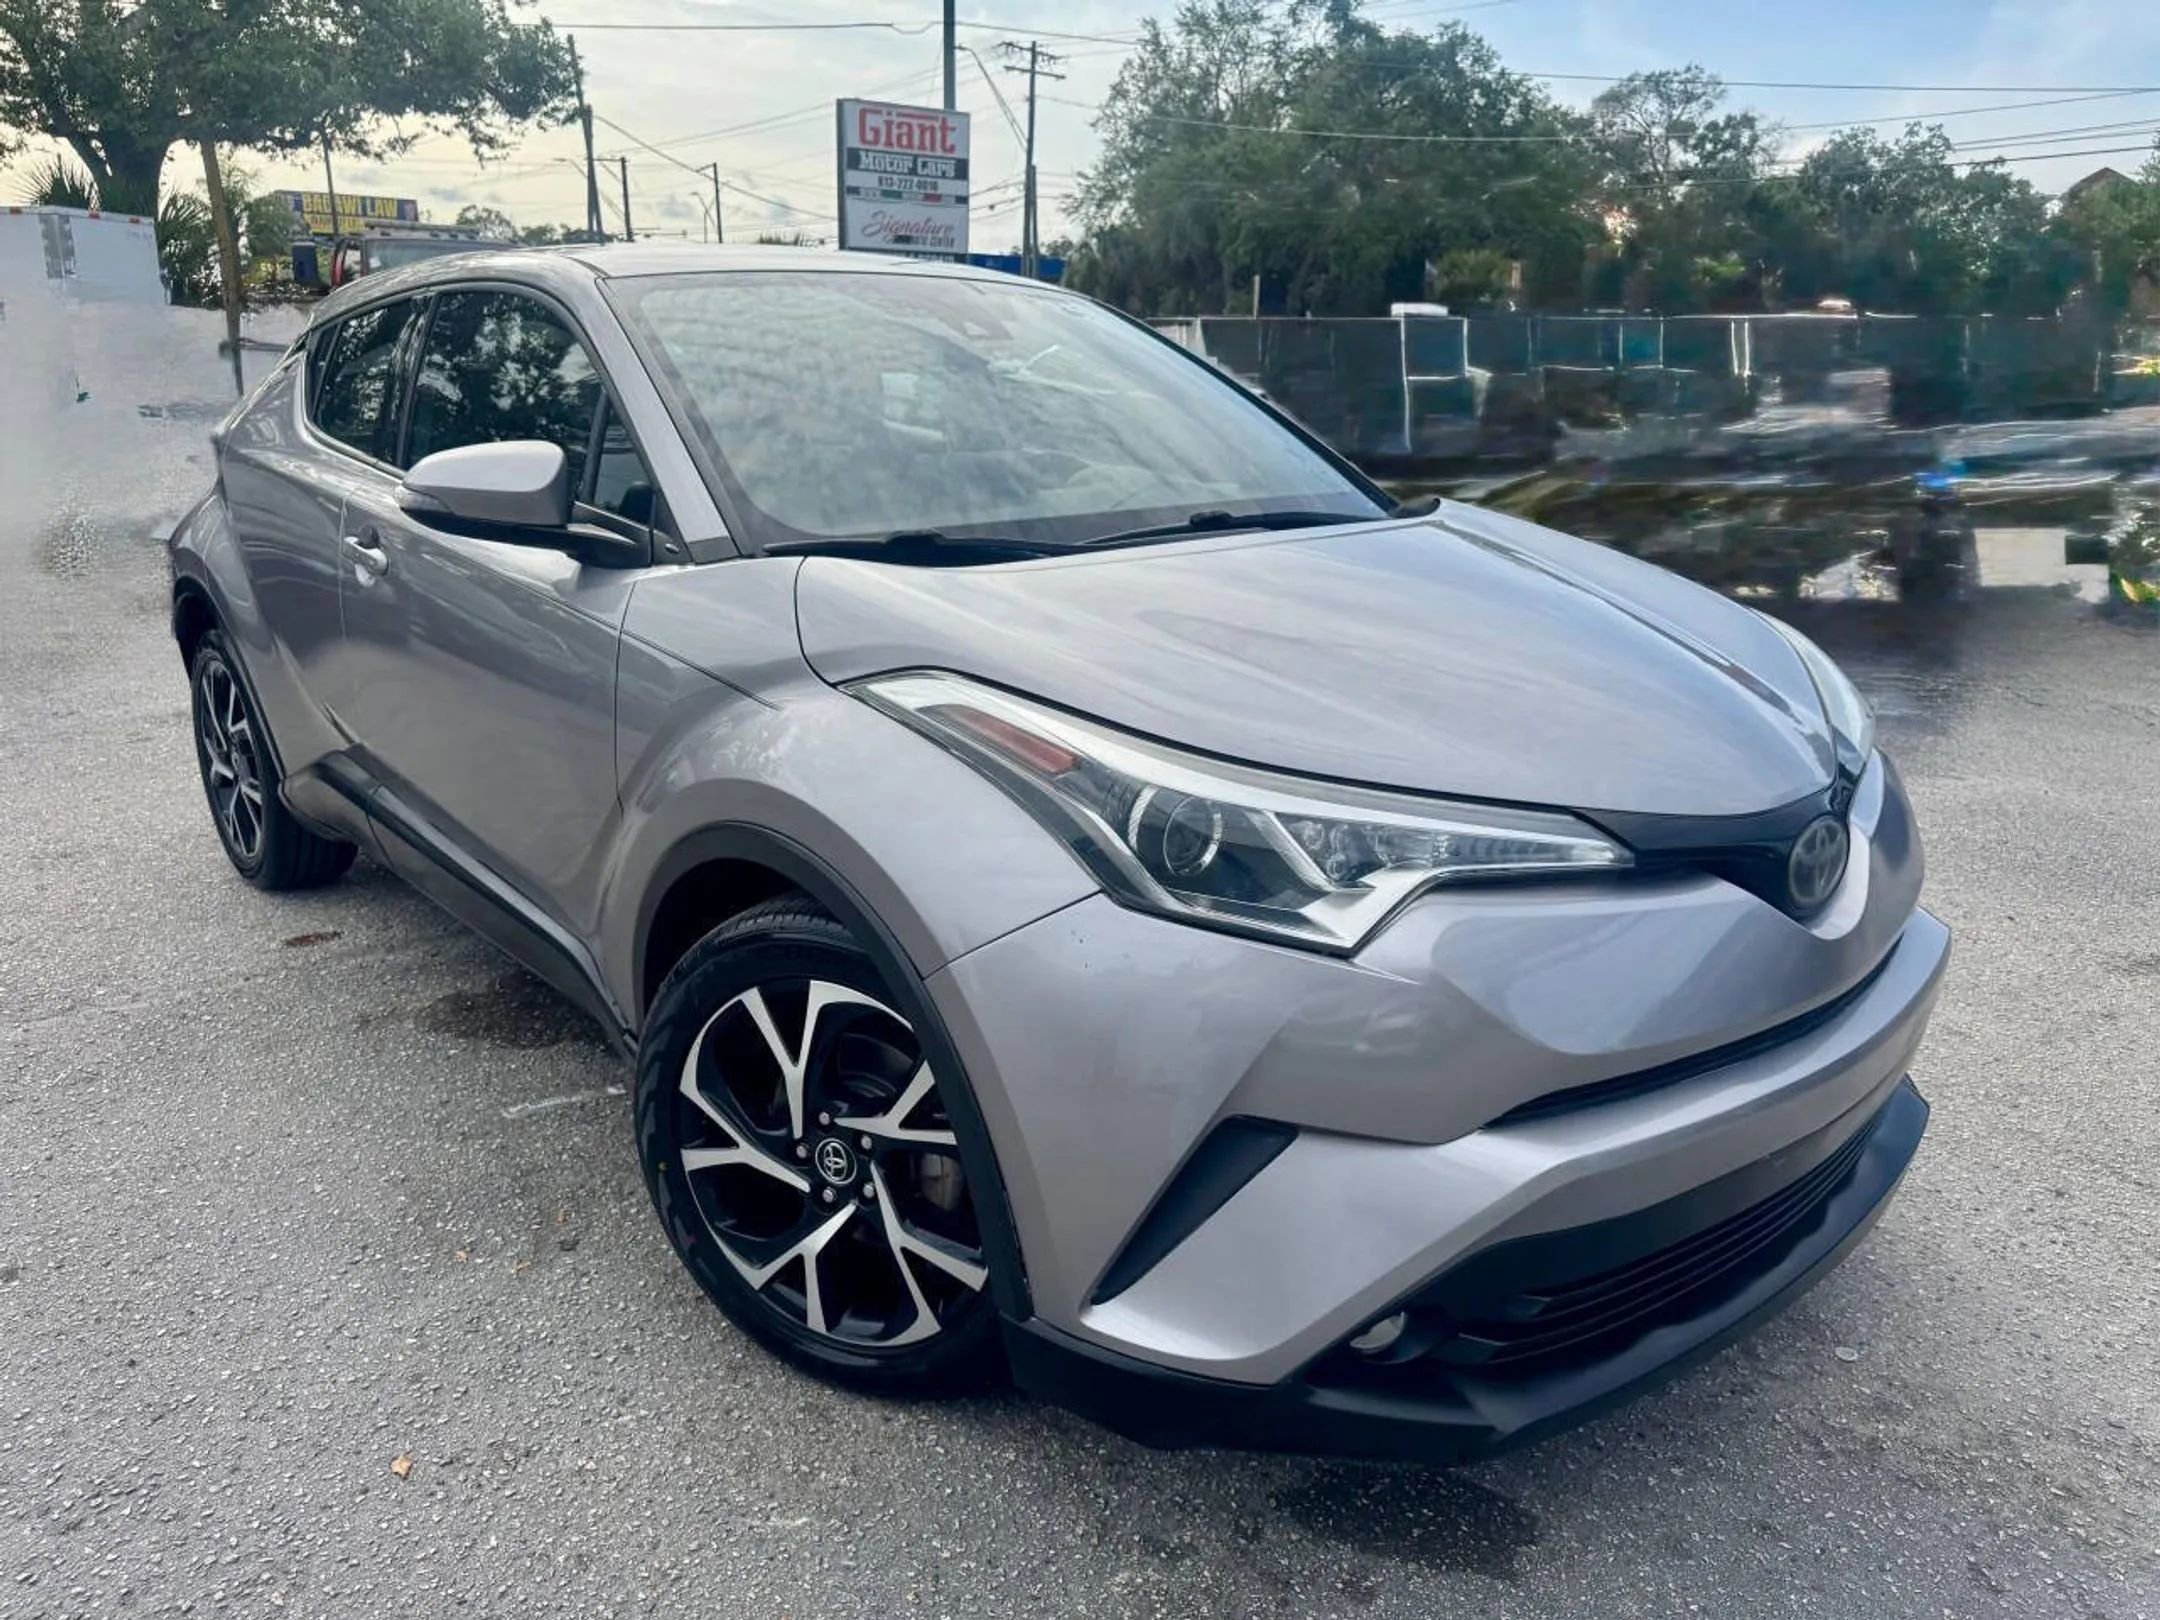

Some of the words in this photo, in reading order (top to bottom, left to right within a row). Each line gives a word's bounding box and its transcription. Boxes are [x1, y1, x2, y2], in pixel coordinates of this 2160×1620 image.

[859, 107, 957, 154] Giant
[859, 151, 914, 175] Motor
[917, 157, 957, 178] Cars
[367, 197, 398, 218] LAW
[862, 210, 954, 239] Signature
